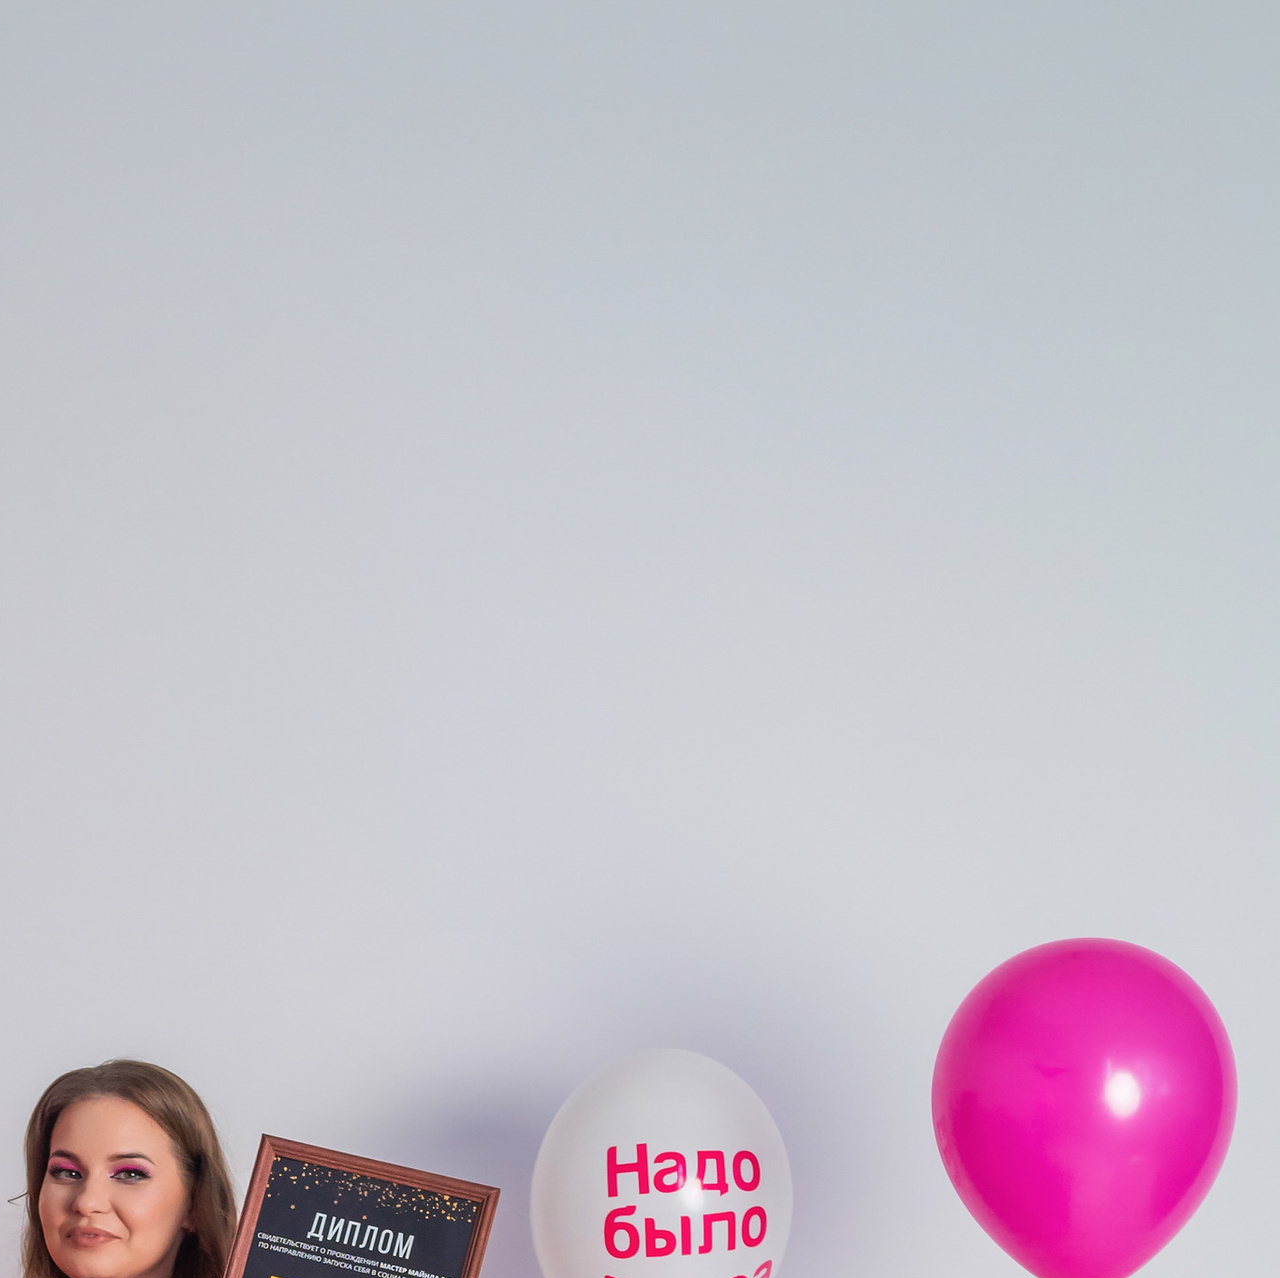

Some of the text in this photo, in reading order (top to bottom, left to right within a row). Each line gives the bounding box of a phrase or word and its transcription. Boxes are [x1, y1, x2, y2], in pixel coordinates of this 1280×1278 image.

[605, 1142, 762, 1198] Надо
[257, 1232, 319, 1252] СВИДЕТЕЛЬСТВУЕТ
[326, 1249, 379, 1267] ПРОХОЖДЕНИИ
[379, 1262, 407, 1273] МАСТЕР
[306, 1212, 414, 1259] ДИПЛОМ
[603, 1205, 768, 1259] было
[257, 1241, 269, 1249] ПО
[269, 1244, 322, 1262] НАПРАВЛЕНИЮ
[322, 1257, 352, 1269] ЗАПУСКА
[353, 1265, 370, 1274] СЕБЯ
